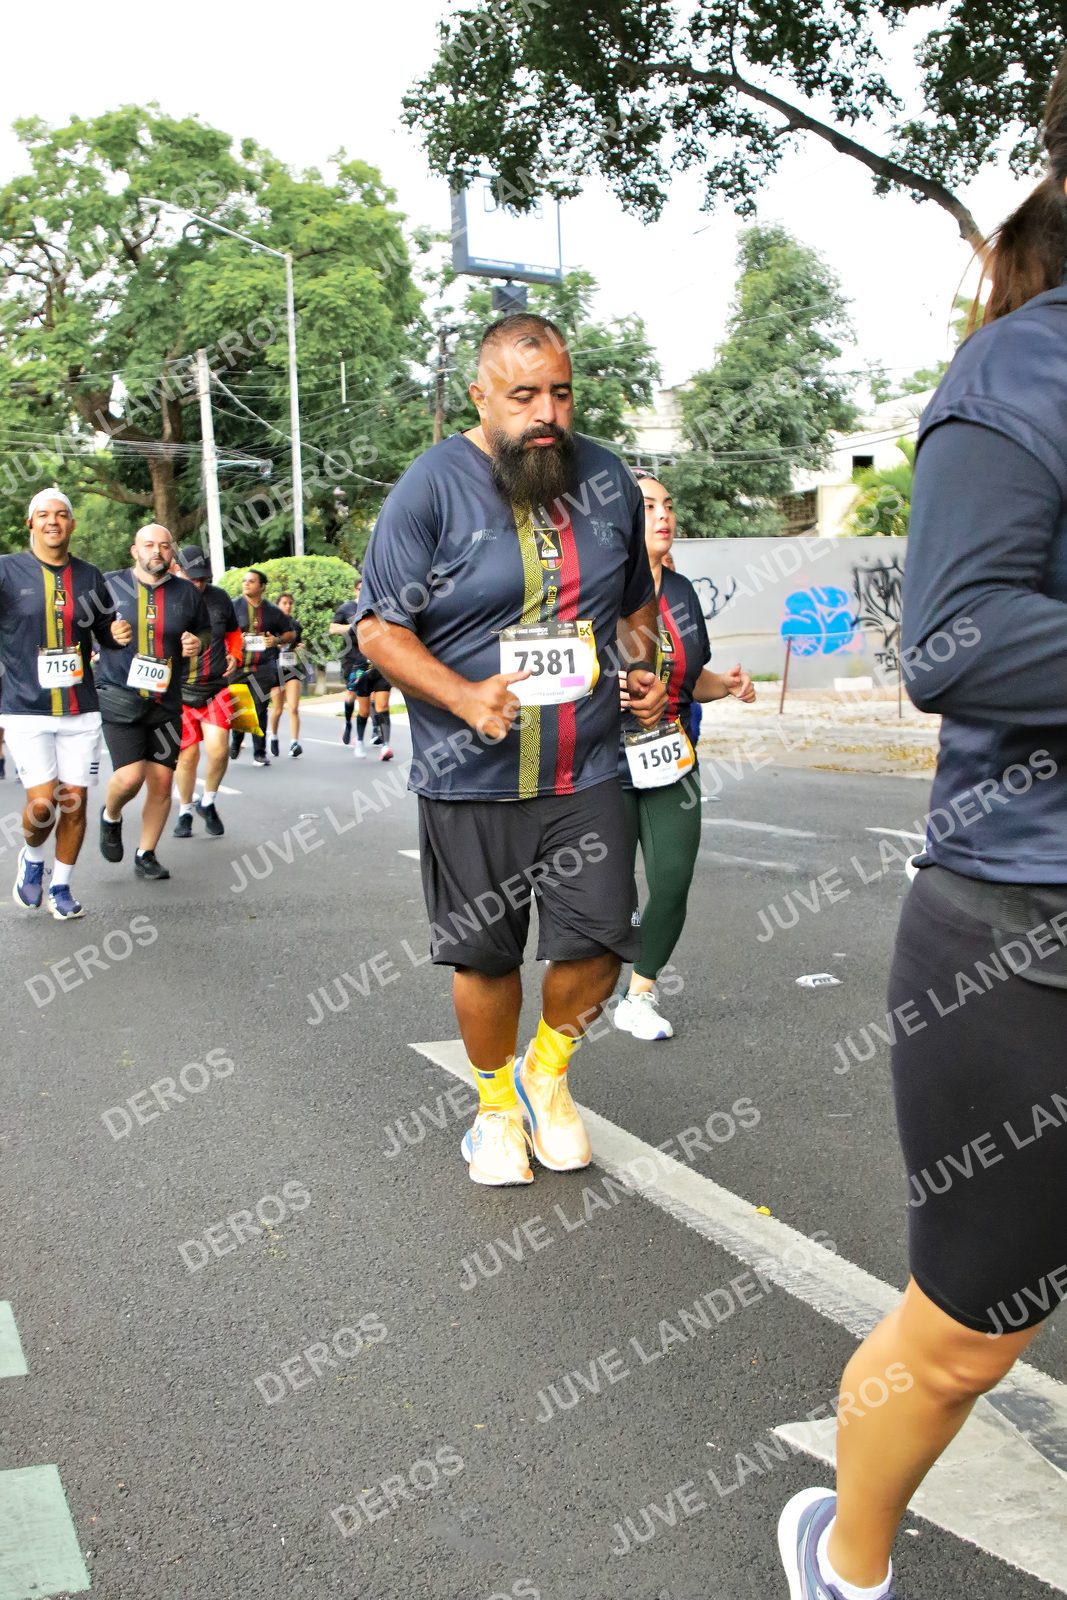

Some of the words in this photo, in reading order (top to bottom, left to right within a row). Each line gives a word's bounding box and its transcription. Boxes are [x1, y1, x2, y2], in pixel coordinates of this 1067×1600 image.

[46, 660, 76, 674] 7156
[136, 664, 165, 680] 7100
[514, 648, 576, 677] 7381
[638, 741, 682, 770] 1505
